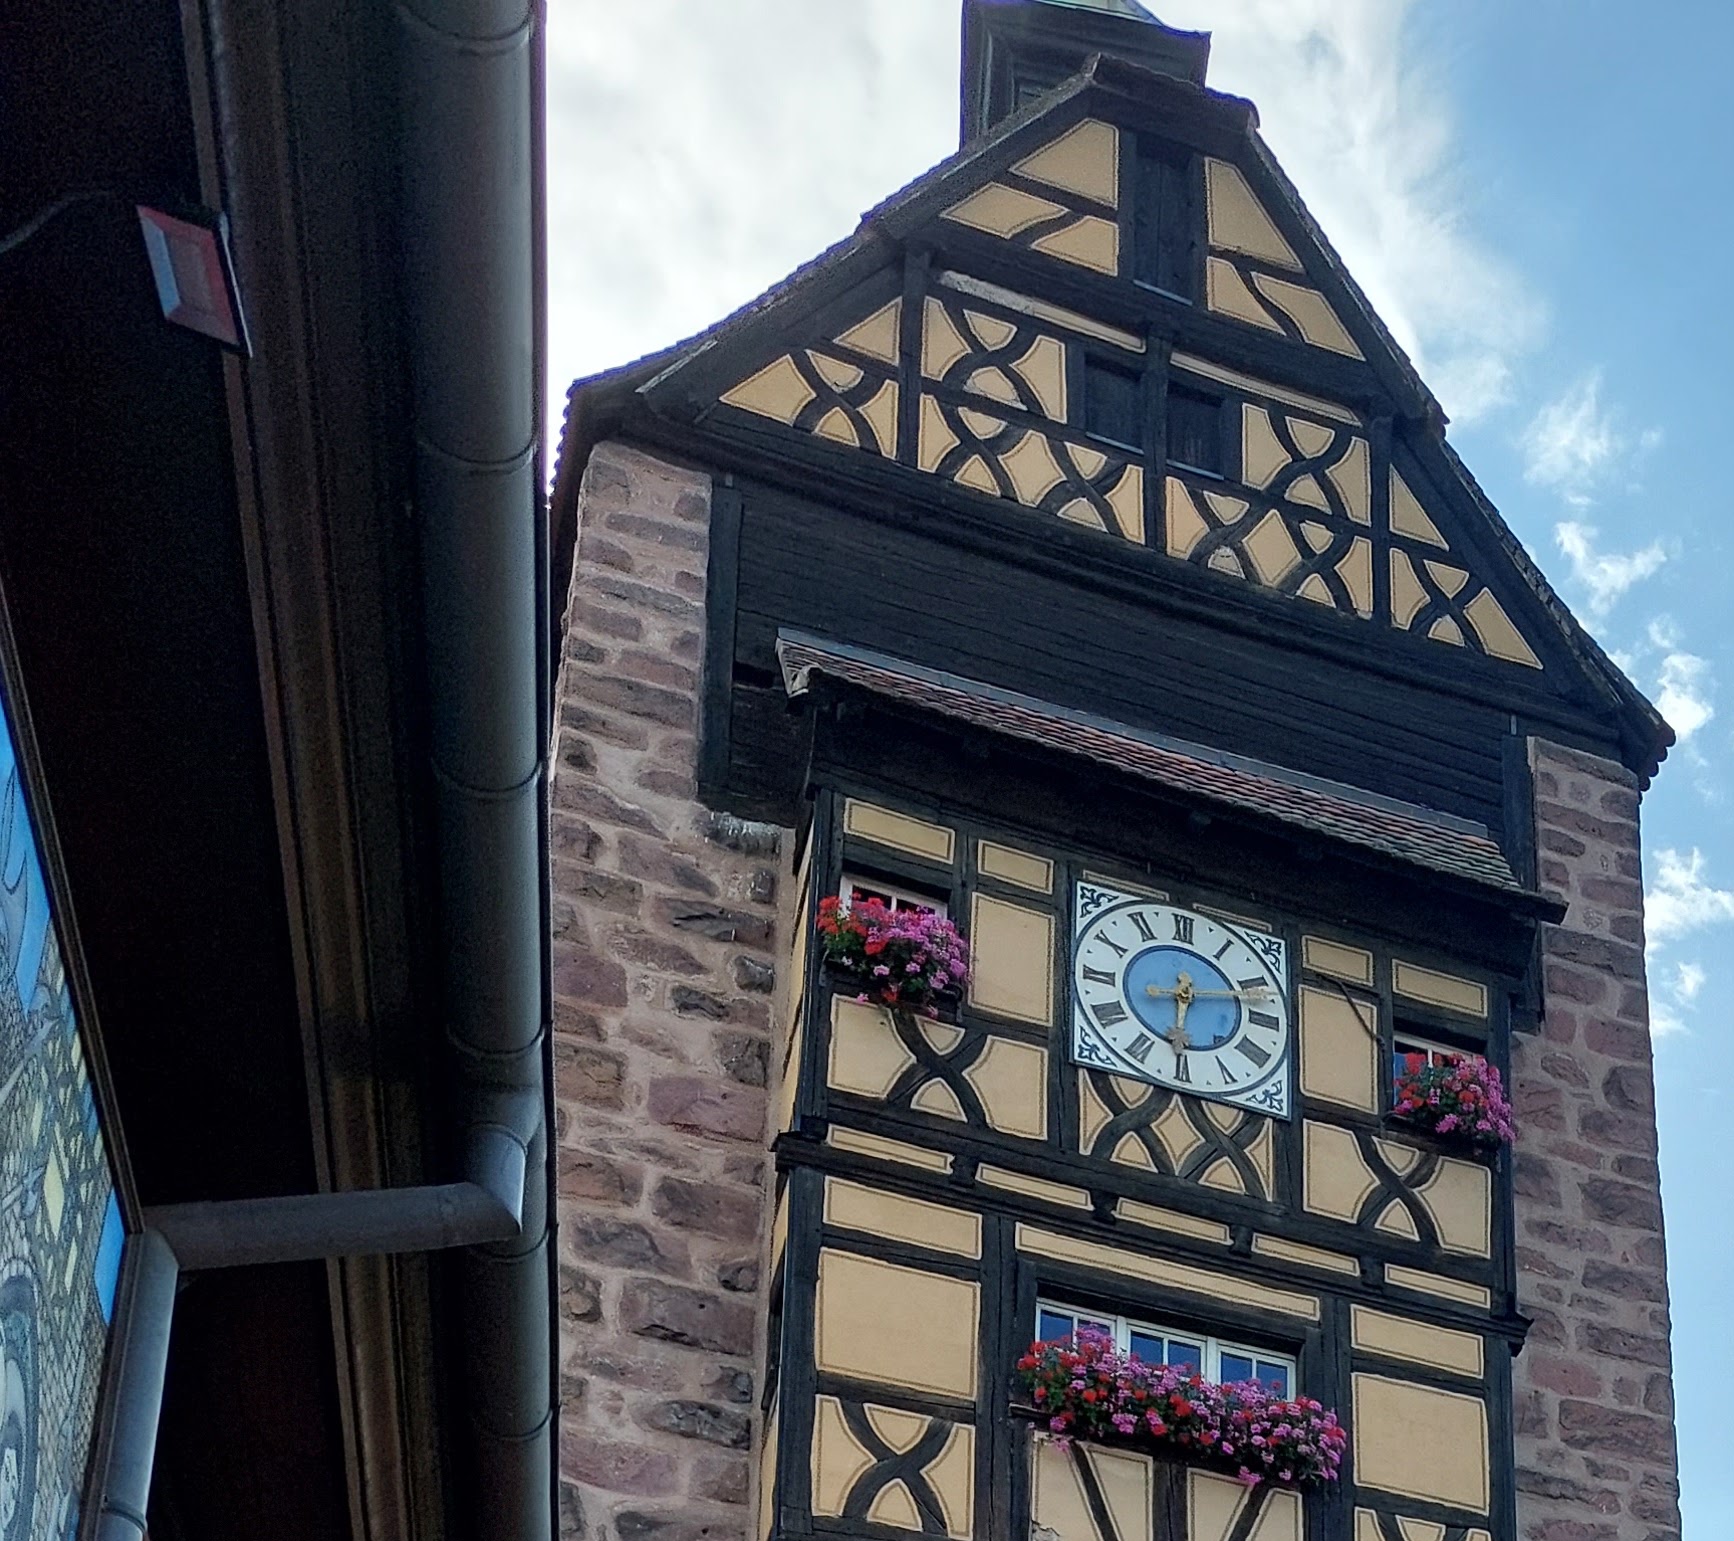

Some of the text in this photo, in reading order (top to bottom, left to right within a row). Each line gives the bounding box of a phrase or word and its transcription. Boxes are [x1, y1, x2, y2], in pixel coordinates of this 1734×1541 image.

[1127, 911, 1158, 943] XI
[1171, 912, 1196, 946] XII
[1094, 929, 1129, 958] X
[1213, 938, 1235, 961] I
[1215, 1055, 1238, 1086] V
